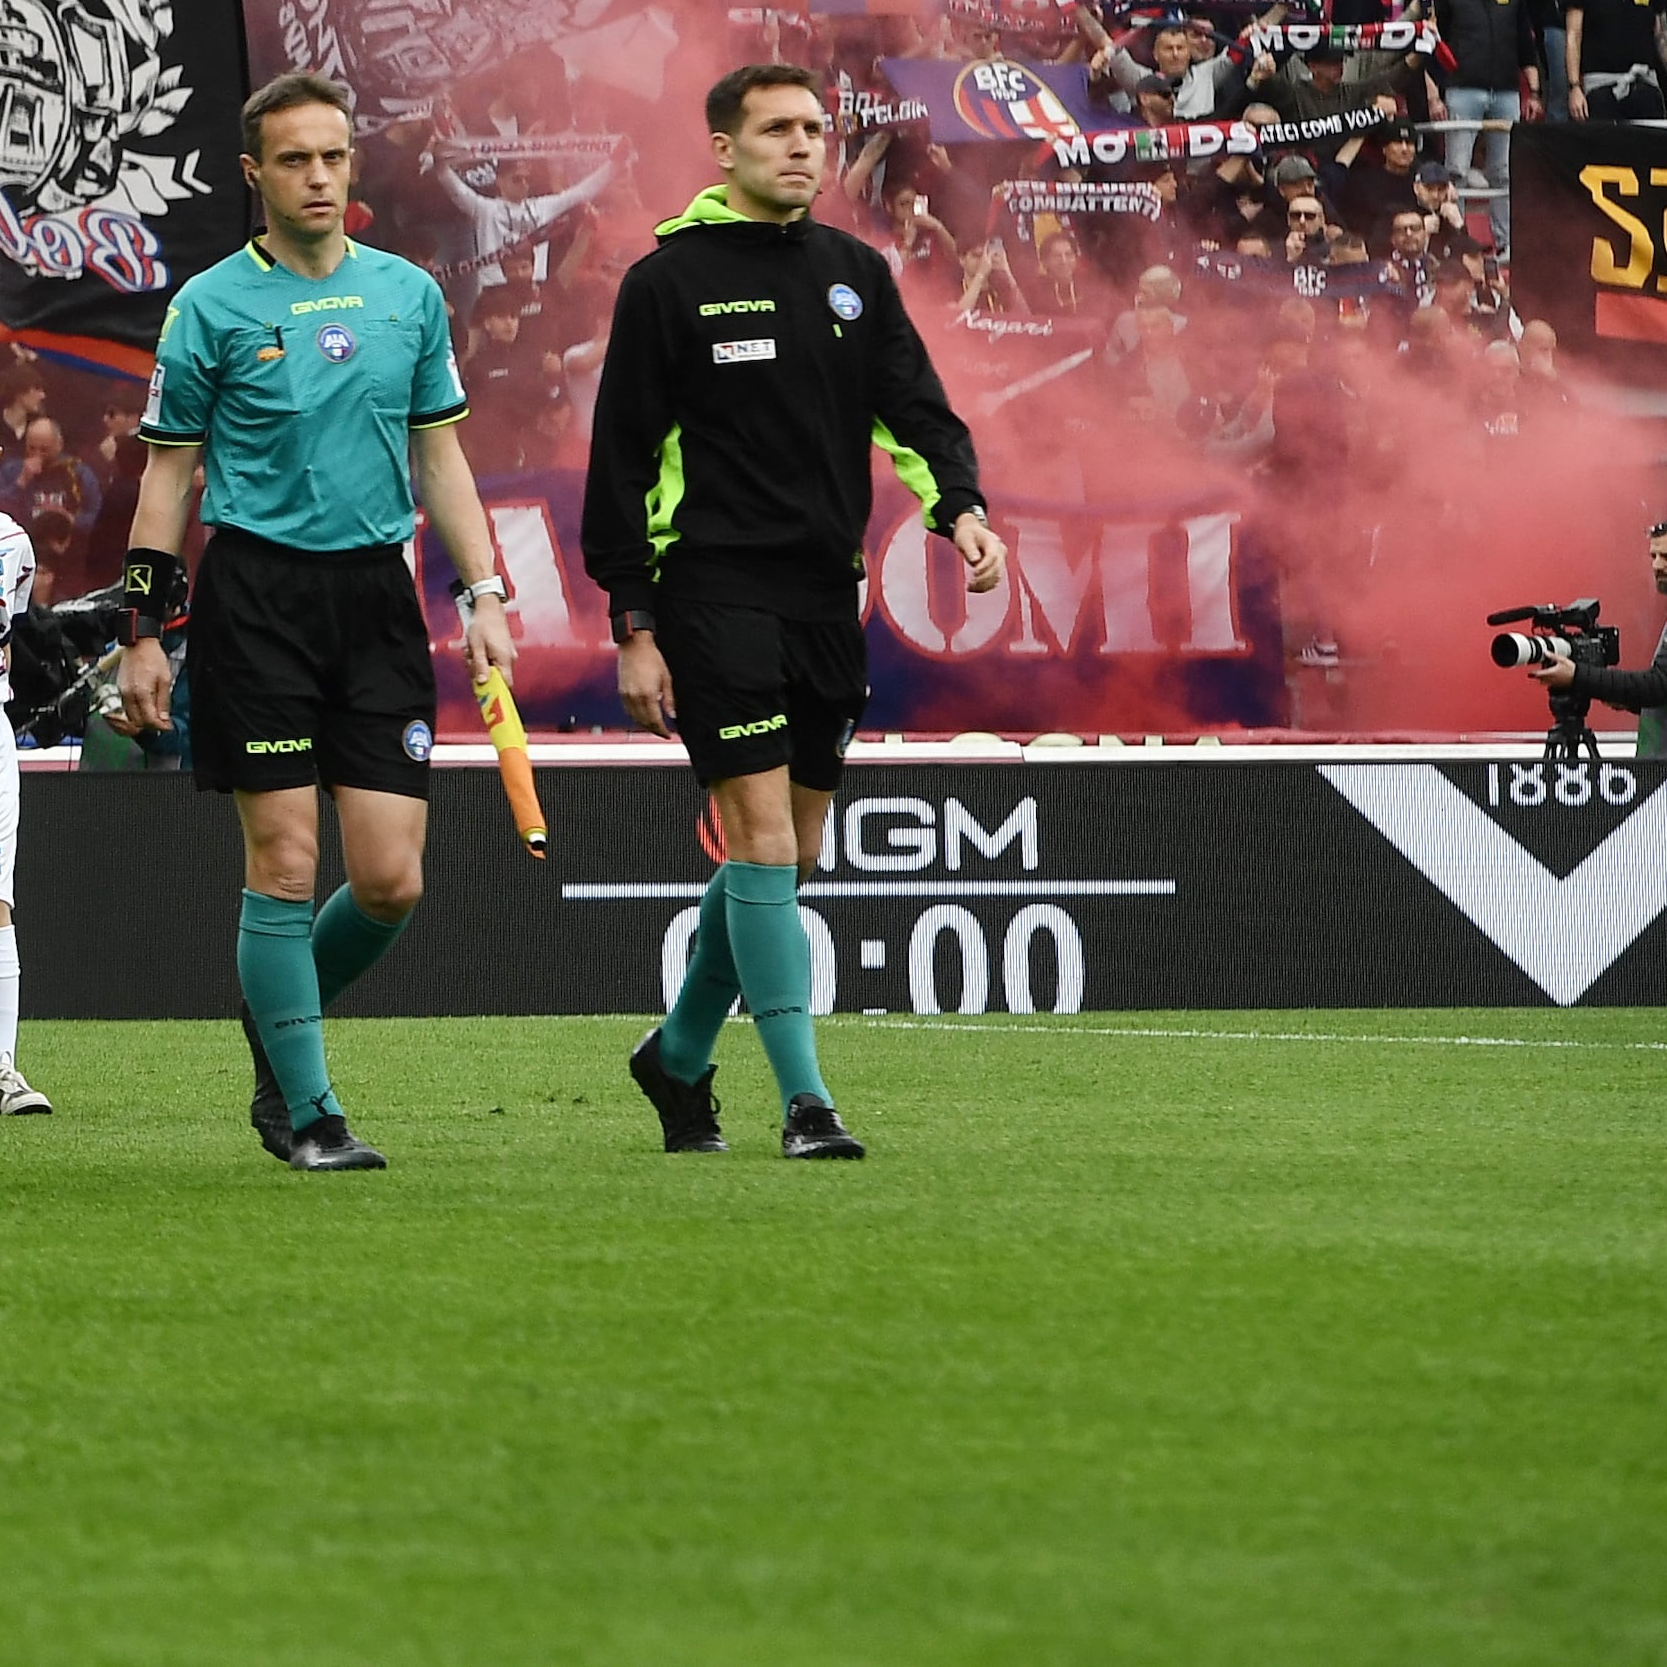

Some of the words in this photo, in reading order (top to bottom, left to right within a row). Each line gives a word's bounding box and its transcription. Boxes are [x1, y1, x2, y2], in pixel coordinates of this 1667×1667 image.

[972, 63, 1026, 92] BFC
[1301, 115, 1344, 140] COME
[290, 294, 364, 316] GIVOVA
[699, 300, 776, 317] GIVOVA
[735, 340, 774, 355] NET
[719, 714, 788, 739] GIVOVA
[246, 737, 312, 754] GIVOVA
